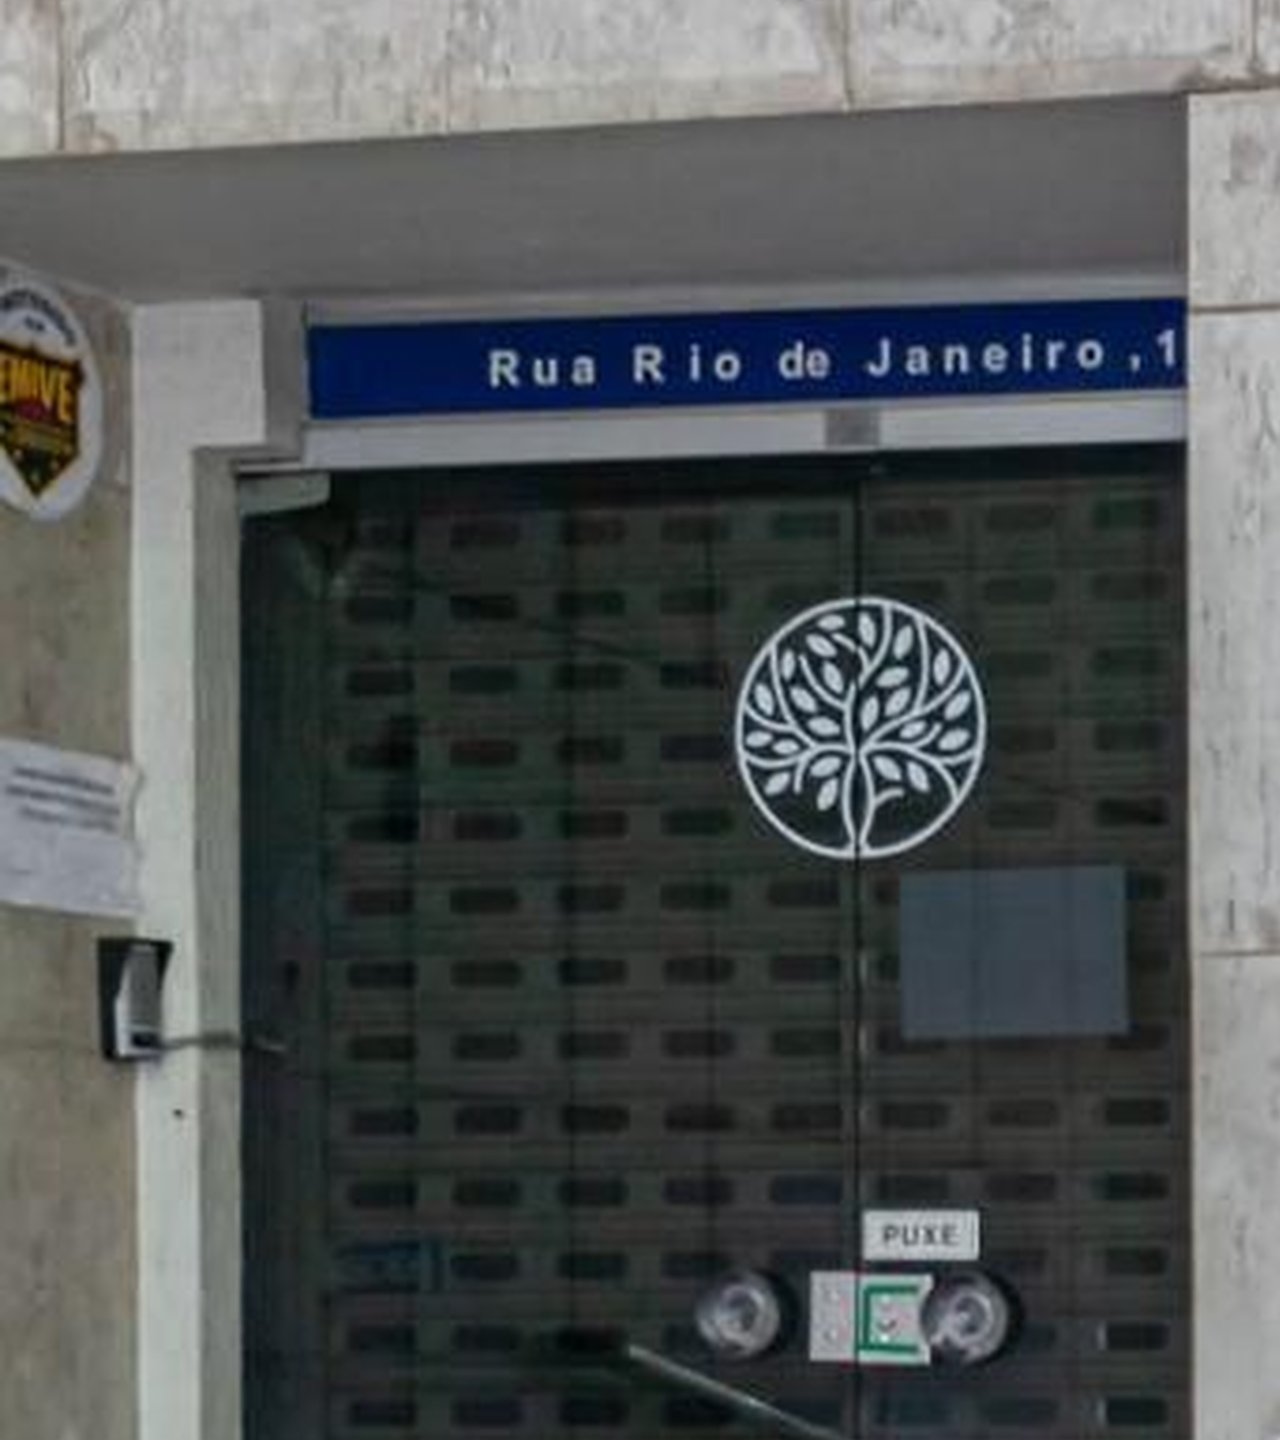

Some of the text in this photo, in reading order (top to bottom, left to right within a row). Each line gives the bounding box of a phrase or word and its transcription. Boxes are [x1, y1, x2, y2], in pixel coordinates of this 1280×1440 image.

[488, 349, 597, 389] Rua
[632, 343, 742, 384] Rio
[778, 339, 831, 381] de
[882, 1223, 961, 1247] PUXE
